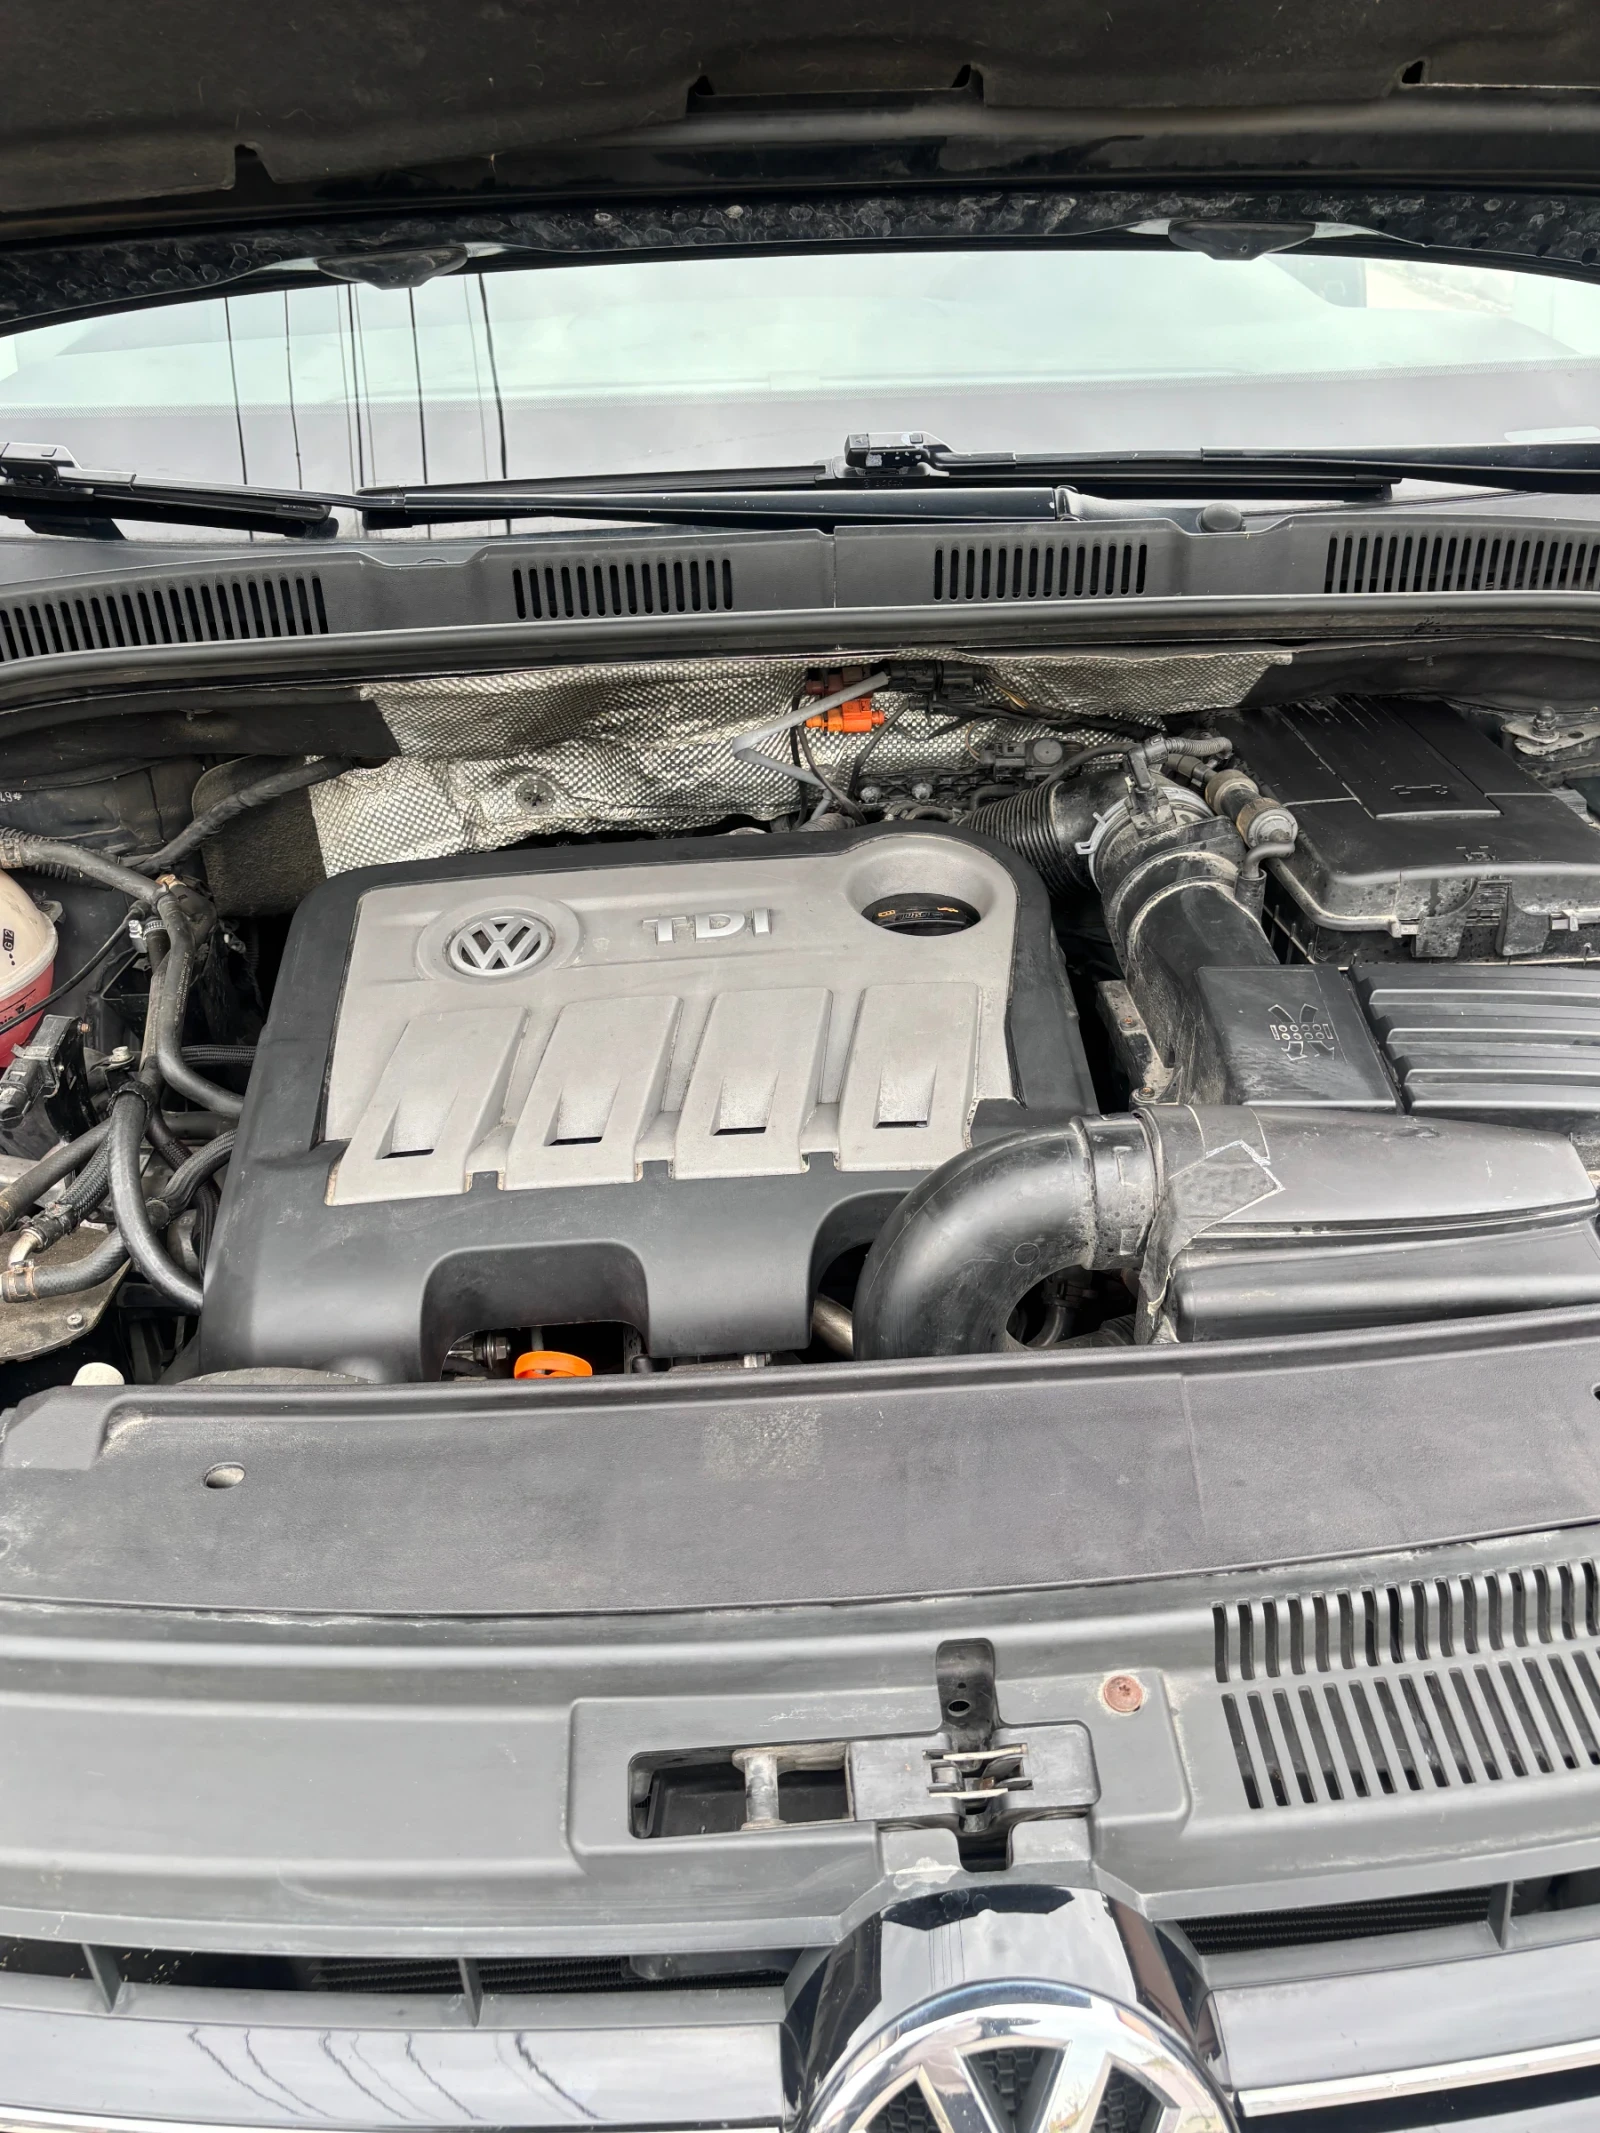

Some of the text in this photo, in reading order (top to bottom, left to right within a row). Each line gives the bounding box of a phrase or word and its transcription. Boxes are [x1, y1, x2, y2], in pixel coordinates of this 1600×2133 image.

[3, 929, 14, 951] G12
[642, 907, 771, 943] TDI
[454, 916, 548, 973] VW
